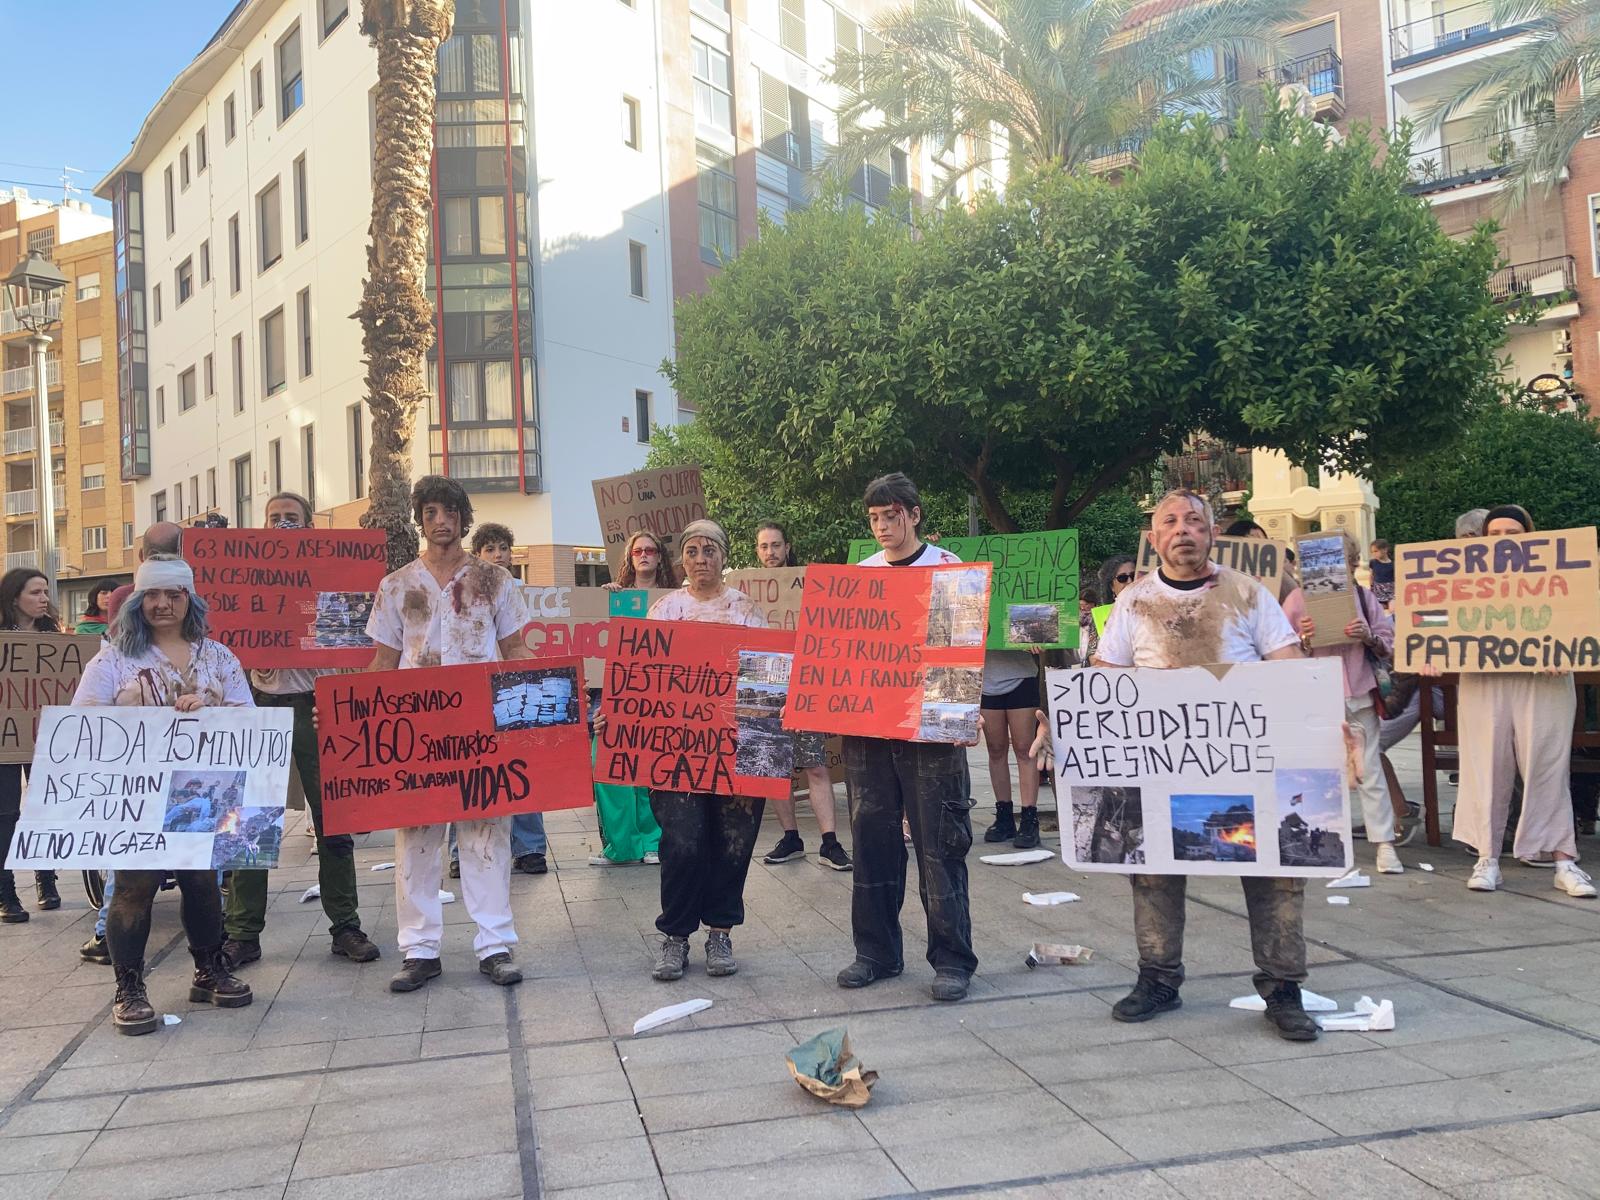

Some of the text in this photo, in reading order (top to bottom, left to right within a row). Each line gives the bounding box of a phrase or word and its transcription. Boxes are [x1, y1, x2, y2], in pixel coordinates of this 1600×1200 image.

[600, 470, 702, 508] NO ES GUERRA
[638, 491, 656, 501] UNA
[607, 520, 620, 532] ES
[607, 532, 625, 543] UN
[193, 536, 386, 563] 63 NIÑOS ASESINADOS
[974, 536, 1077, 571] ASESINO
[1403, 538, 1592, 580] ISRAEL
[220, 567, 312, 588] CISJORDANIA
[869, 579, 886, 600] DE
[1404, 575, 1568, 606] ASESINA
[251, 595, 266, 613] EL
[277, 594, 286, 615] 7
[1457, 604, 1552, 632] UMU
[805, 607, 901, 631] VIVIENDAS
[219, 629, 295, 649] OCTUBRE
[618, 626, 674, 659] HAN
[804, 634, 922, 665] DESTRUIDAS
[1406, 633, 1600, 670] PATROCINA
[800, 665, 824, 686] EN
[832, 668, 851, 687] LA
[1053, 672, 1139, 707] >100
[607, 698, 716, 722] TODAS LAS
[795, 694, 874, 714] DE GAZA
[1057, 701, 1267, 740] PERIODISTAS
[49, 714, 146, 766] CADA
[159, 717, 199, 764] 15
[196, 728, 292, 768] MINUTOS
[322, 736, 336, 755] A
[609, 752, 734, 795] EN GAZA
[1060, 742, 1275, 779] ASESINADOS
[44, 772, 163, 804] ASESINAN
[103, 798, 144, 822] UN
[15, 828, 167, 860] NIÑO EN GAZA
